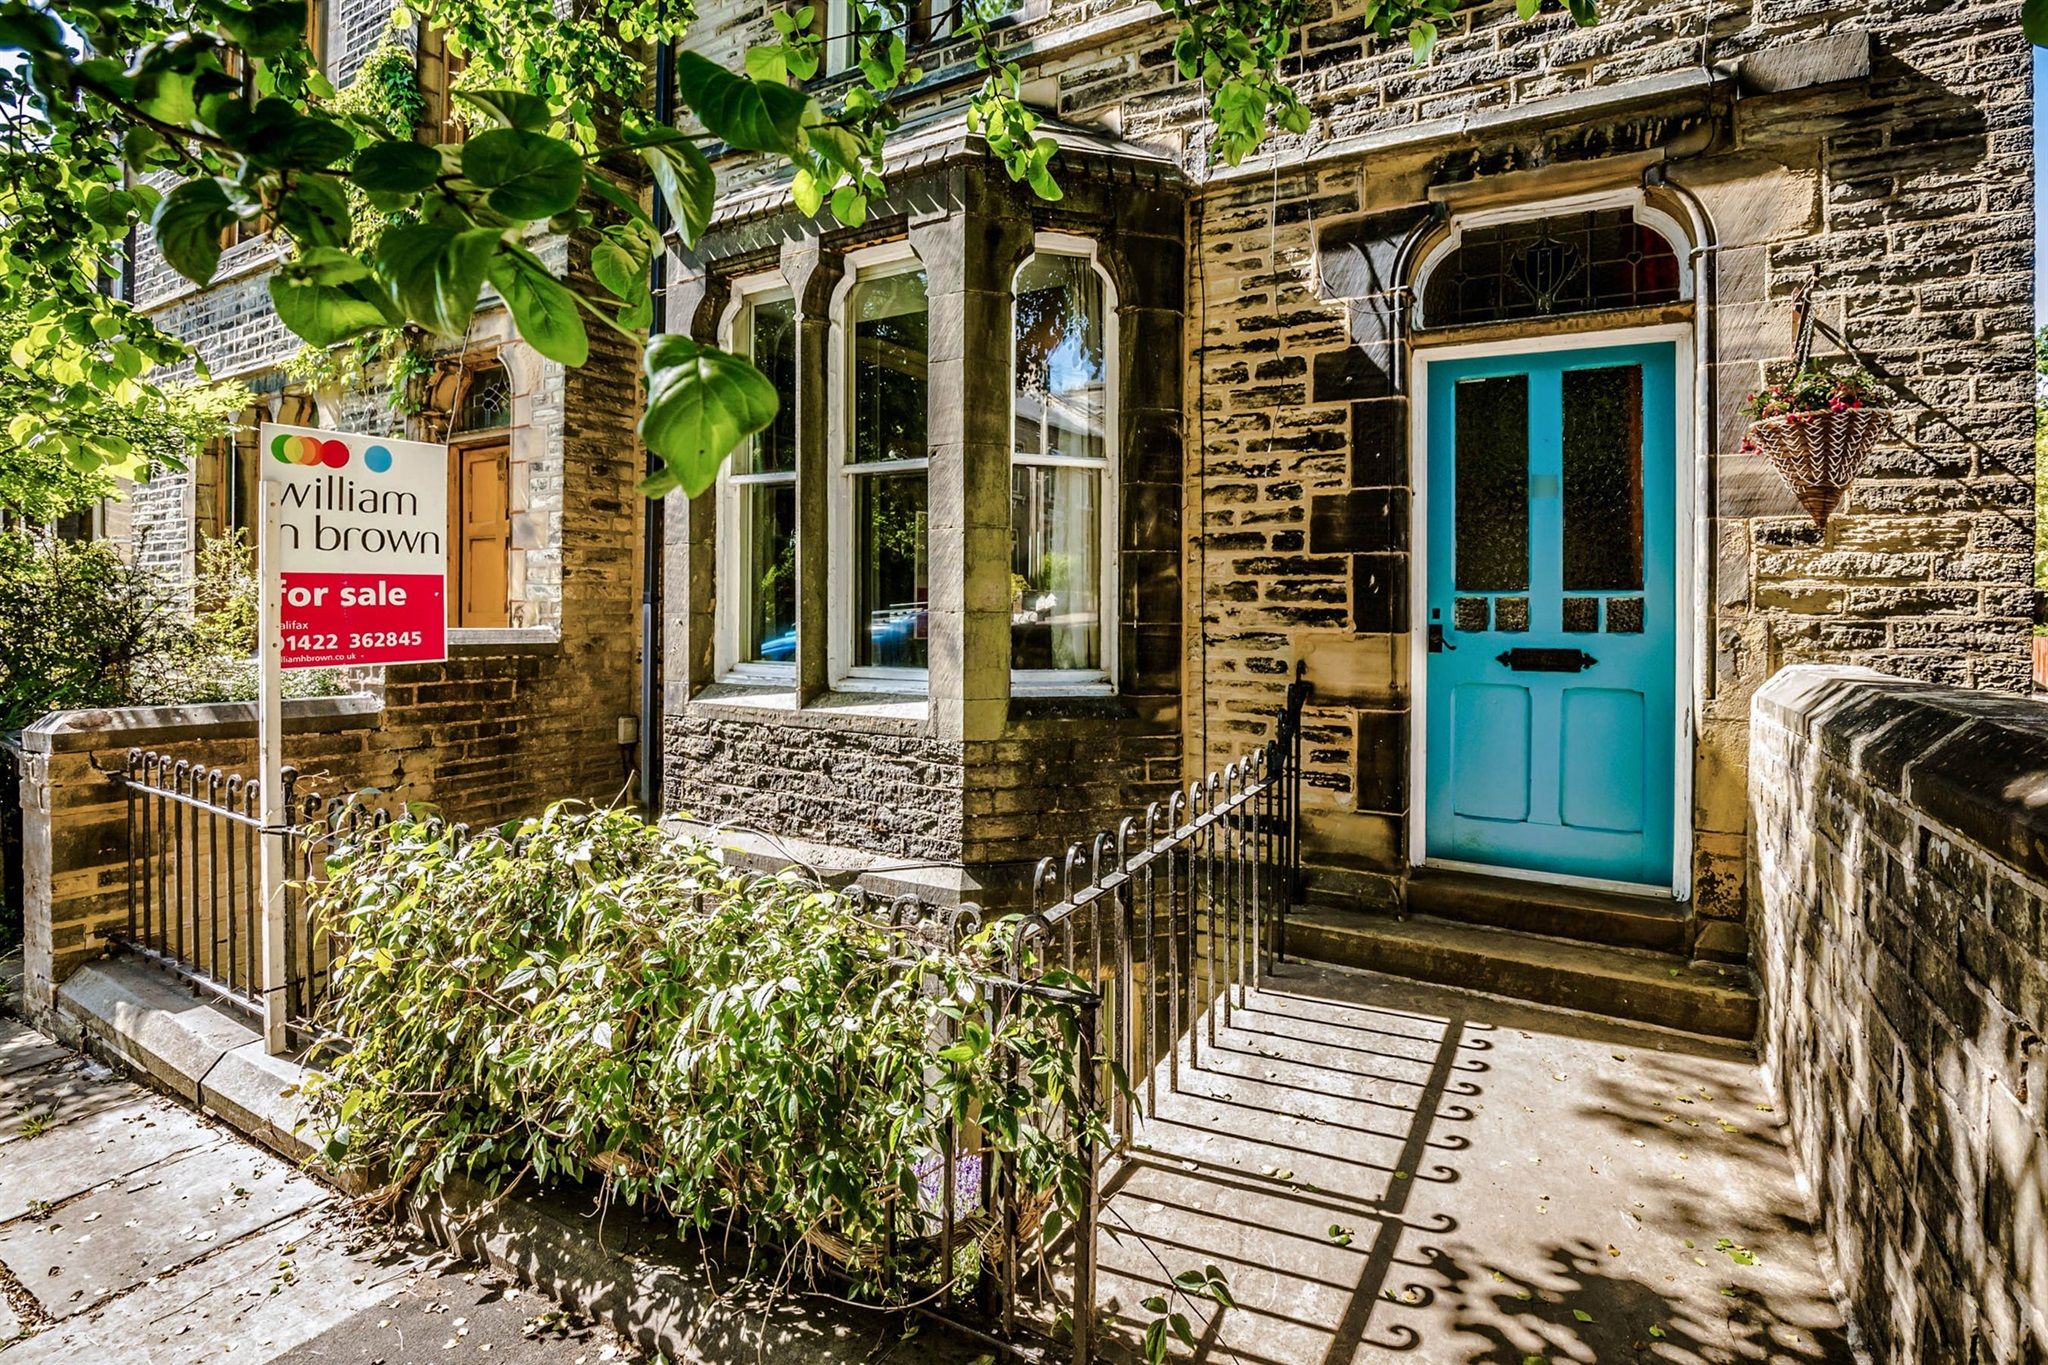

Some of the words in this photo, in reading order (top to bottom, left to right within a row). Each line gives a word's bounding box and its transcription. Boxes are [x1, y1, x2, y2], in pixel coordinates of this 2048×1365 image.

[280, 475, 417, 516] william
[315, 514, 440, 554] brown
[340, 580, 407, 607] sale
[280, 620, 309, 630] alifax
[349, 631, 422, 649] 362845
